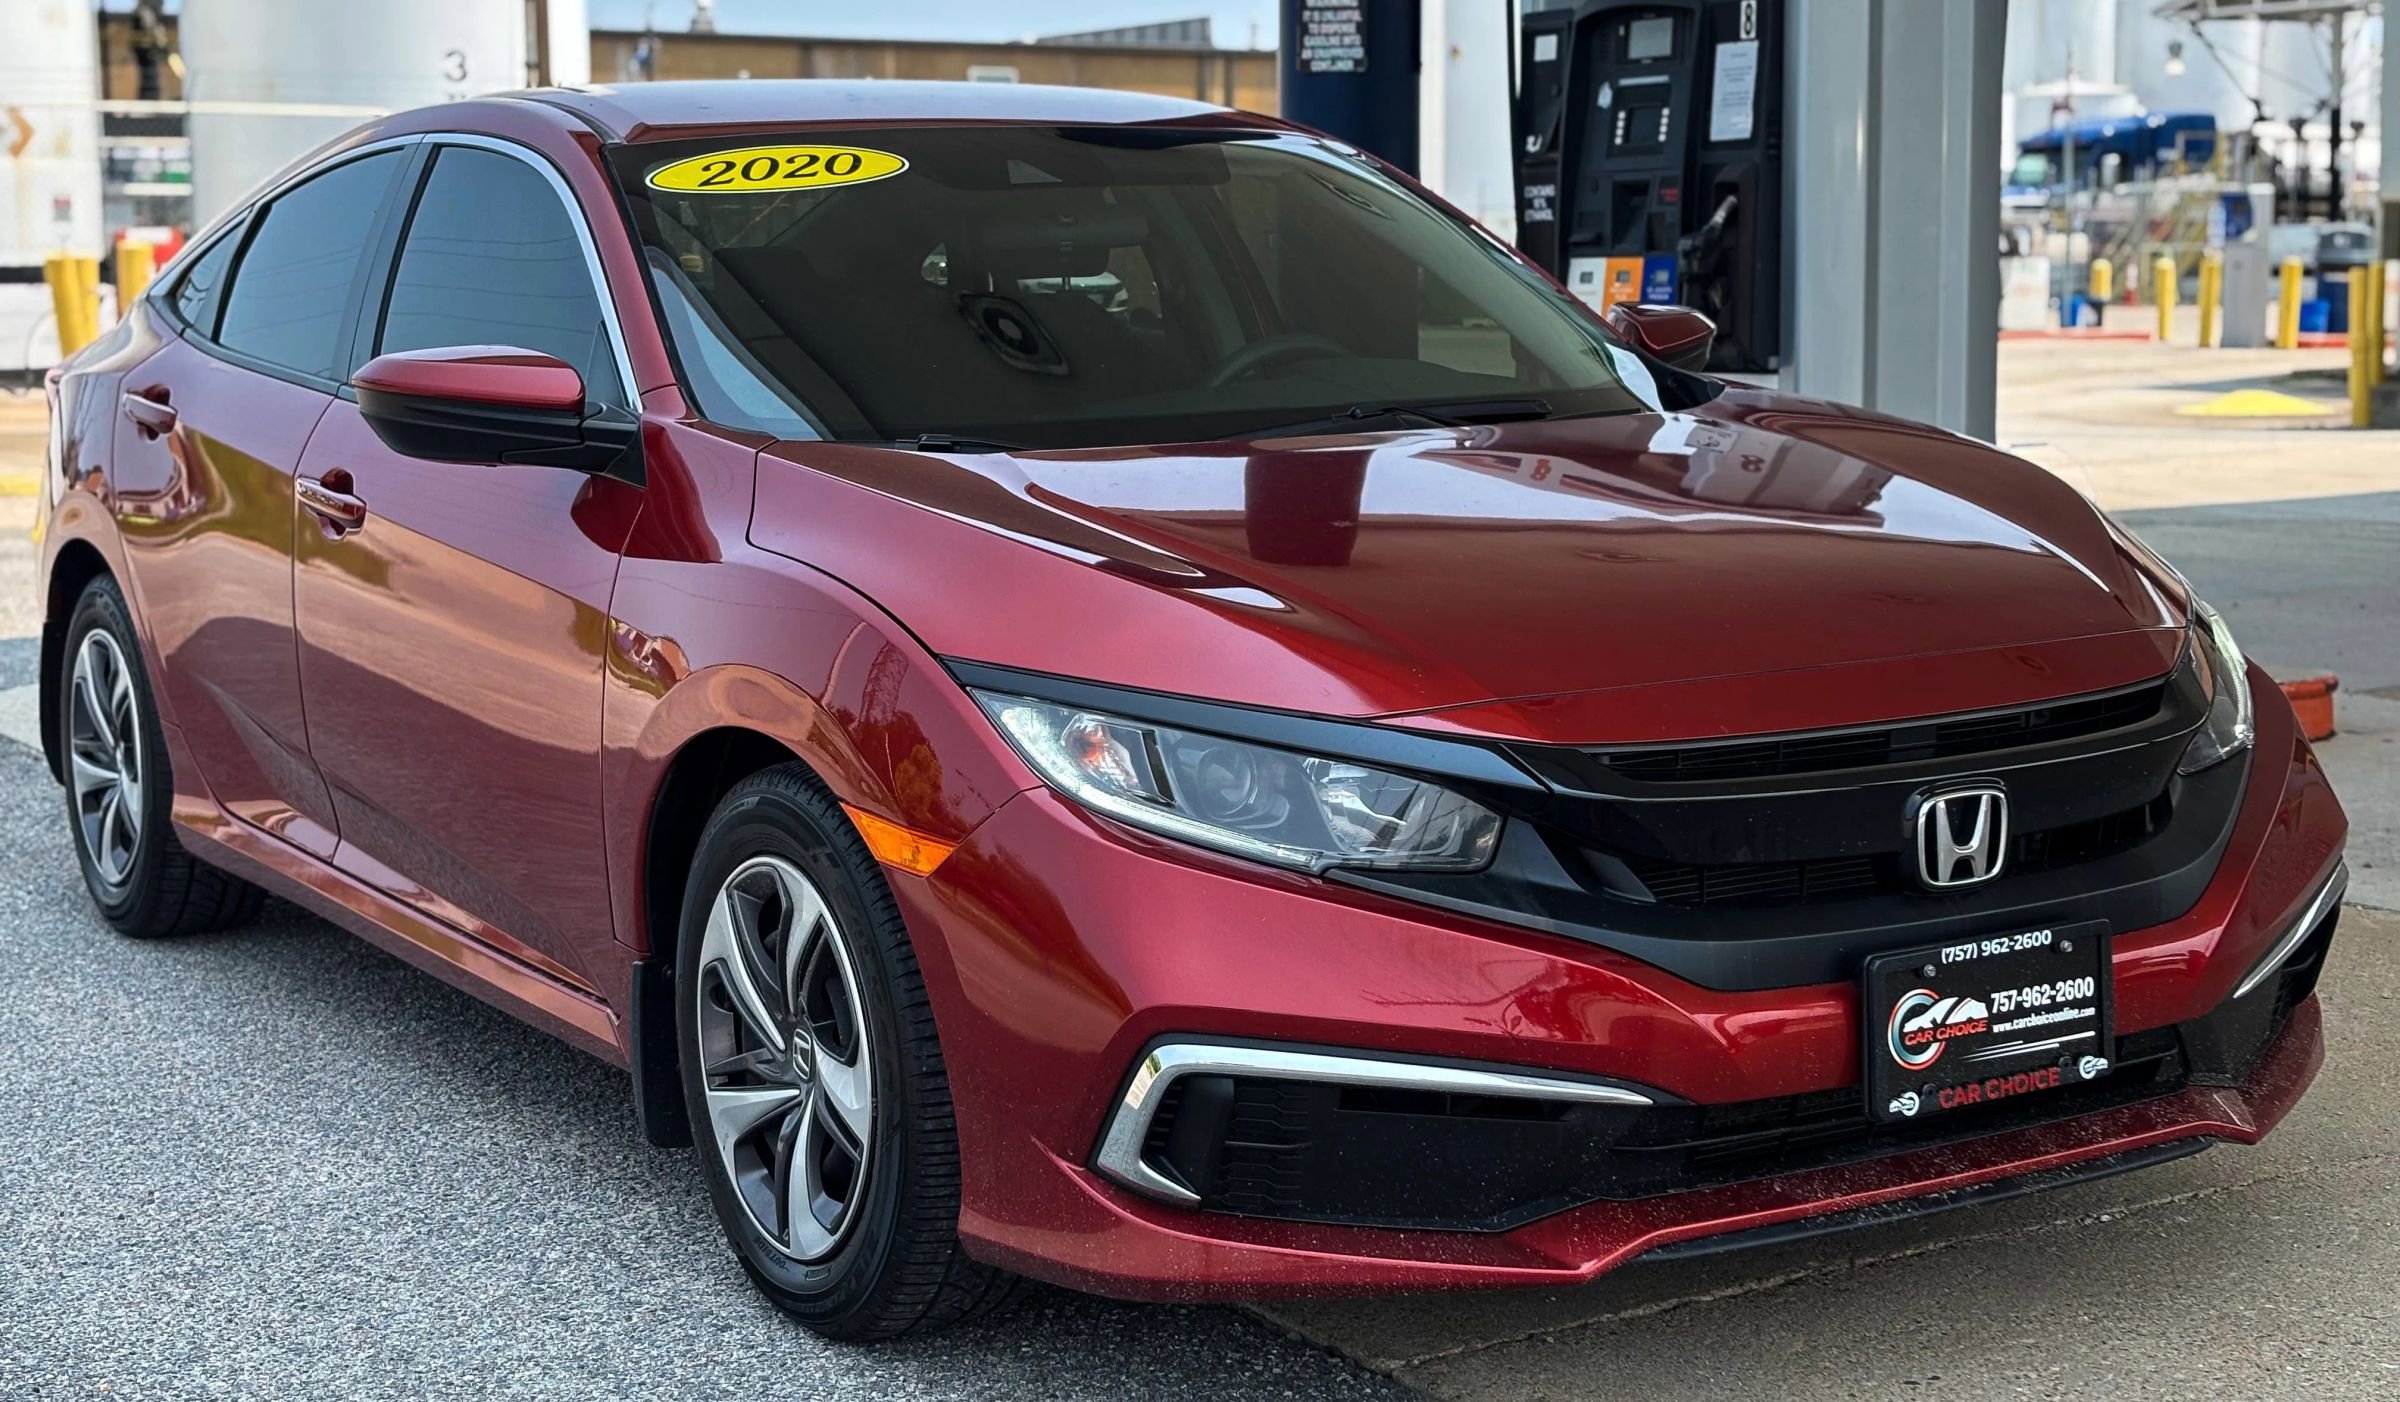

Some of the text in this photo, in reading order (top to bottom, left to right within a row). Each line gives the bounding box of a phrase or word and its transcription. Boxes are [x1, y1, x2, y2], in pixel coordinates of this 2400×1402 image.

[1744, 2, 1753, 36] 8
[445, 51, 467, 82] 3
[698, 152, 863, 187] 2020
[1941, 929, 2052, 965] (757) 962-2600
[1990, 976, 2095, 1013] 757-962-2600
[1904, 1020, 1988, 1046] CAR CHOICE
[1992, 1007, 2096, 1033] www.carchoiceonline.com
[1939, 1084, 1981, 1109] CAR
[1985, 1067, 2061, 1101] CHOICE
